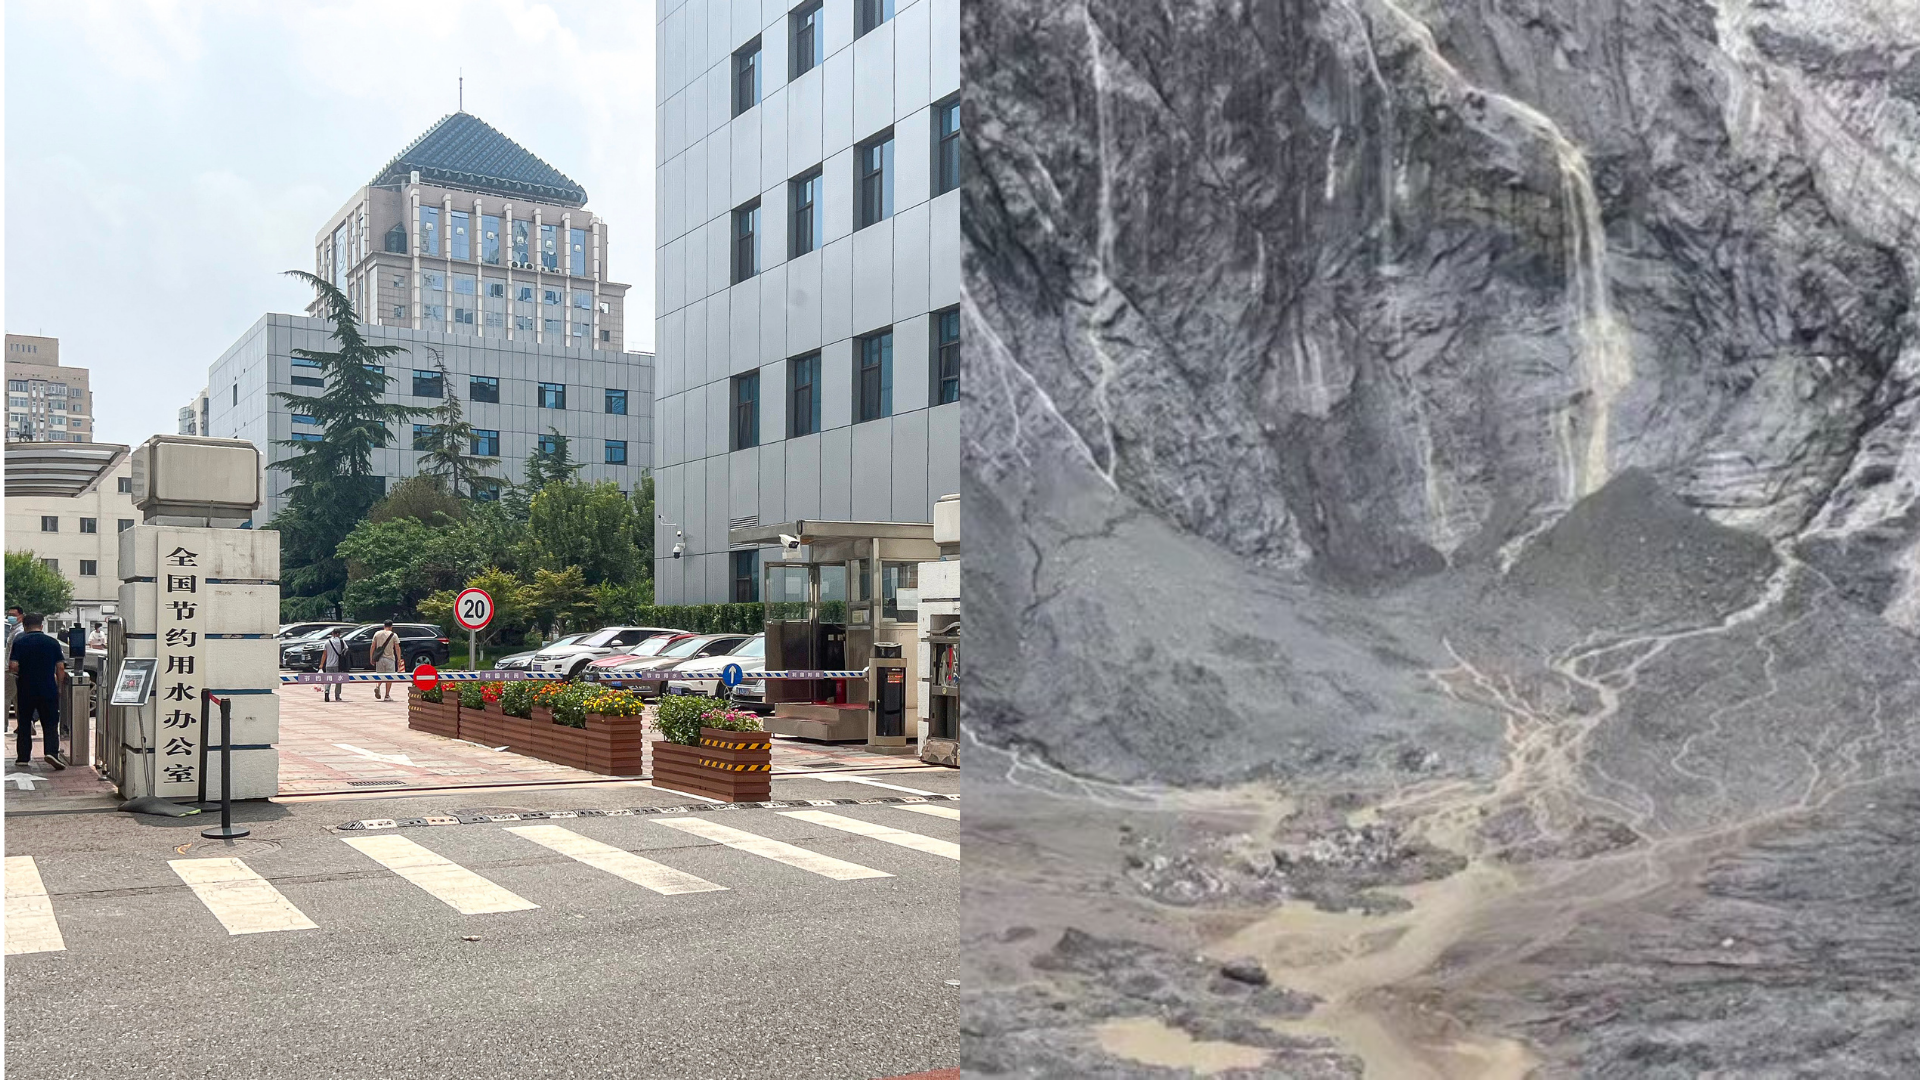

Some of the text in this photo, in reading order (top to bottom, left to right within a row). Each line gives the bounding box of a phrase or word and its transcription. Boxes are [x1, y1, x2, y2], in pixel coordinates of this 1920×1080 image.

[163, 546, 198, 783] 全国节约用水办公室
[464, 599, 485, 619] 20
